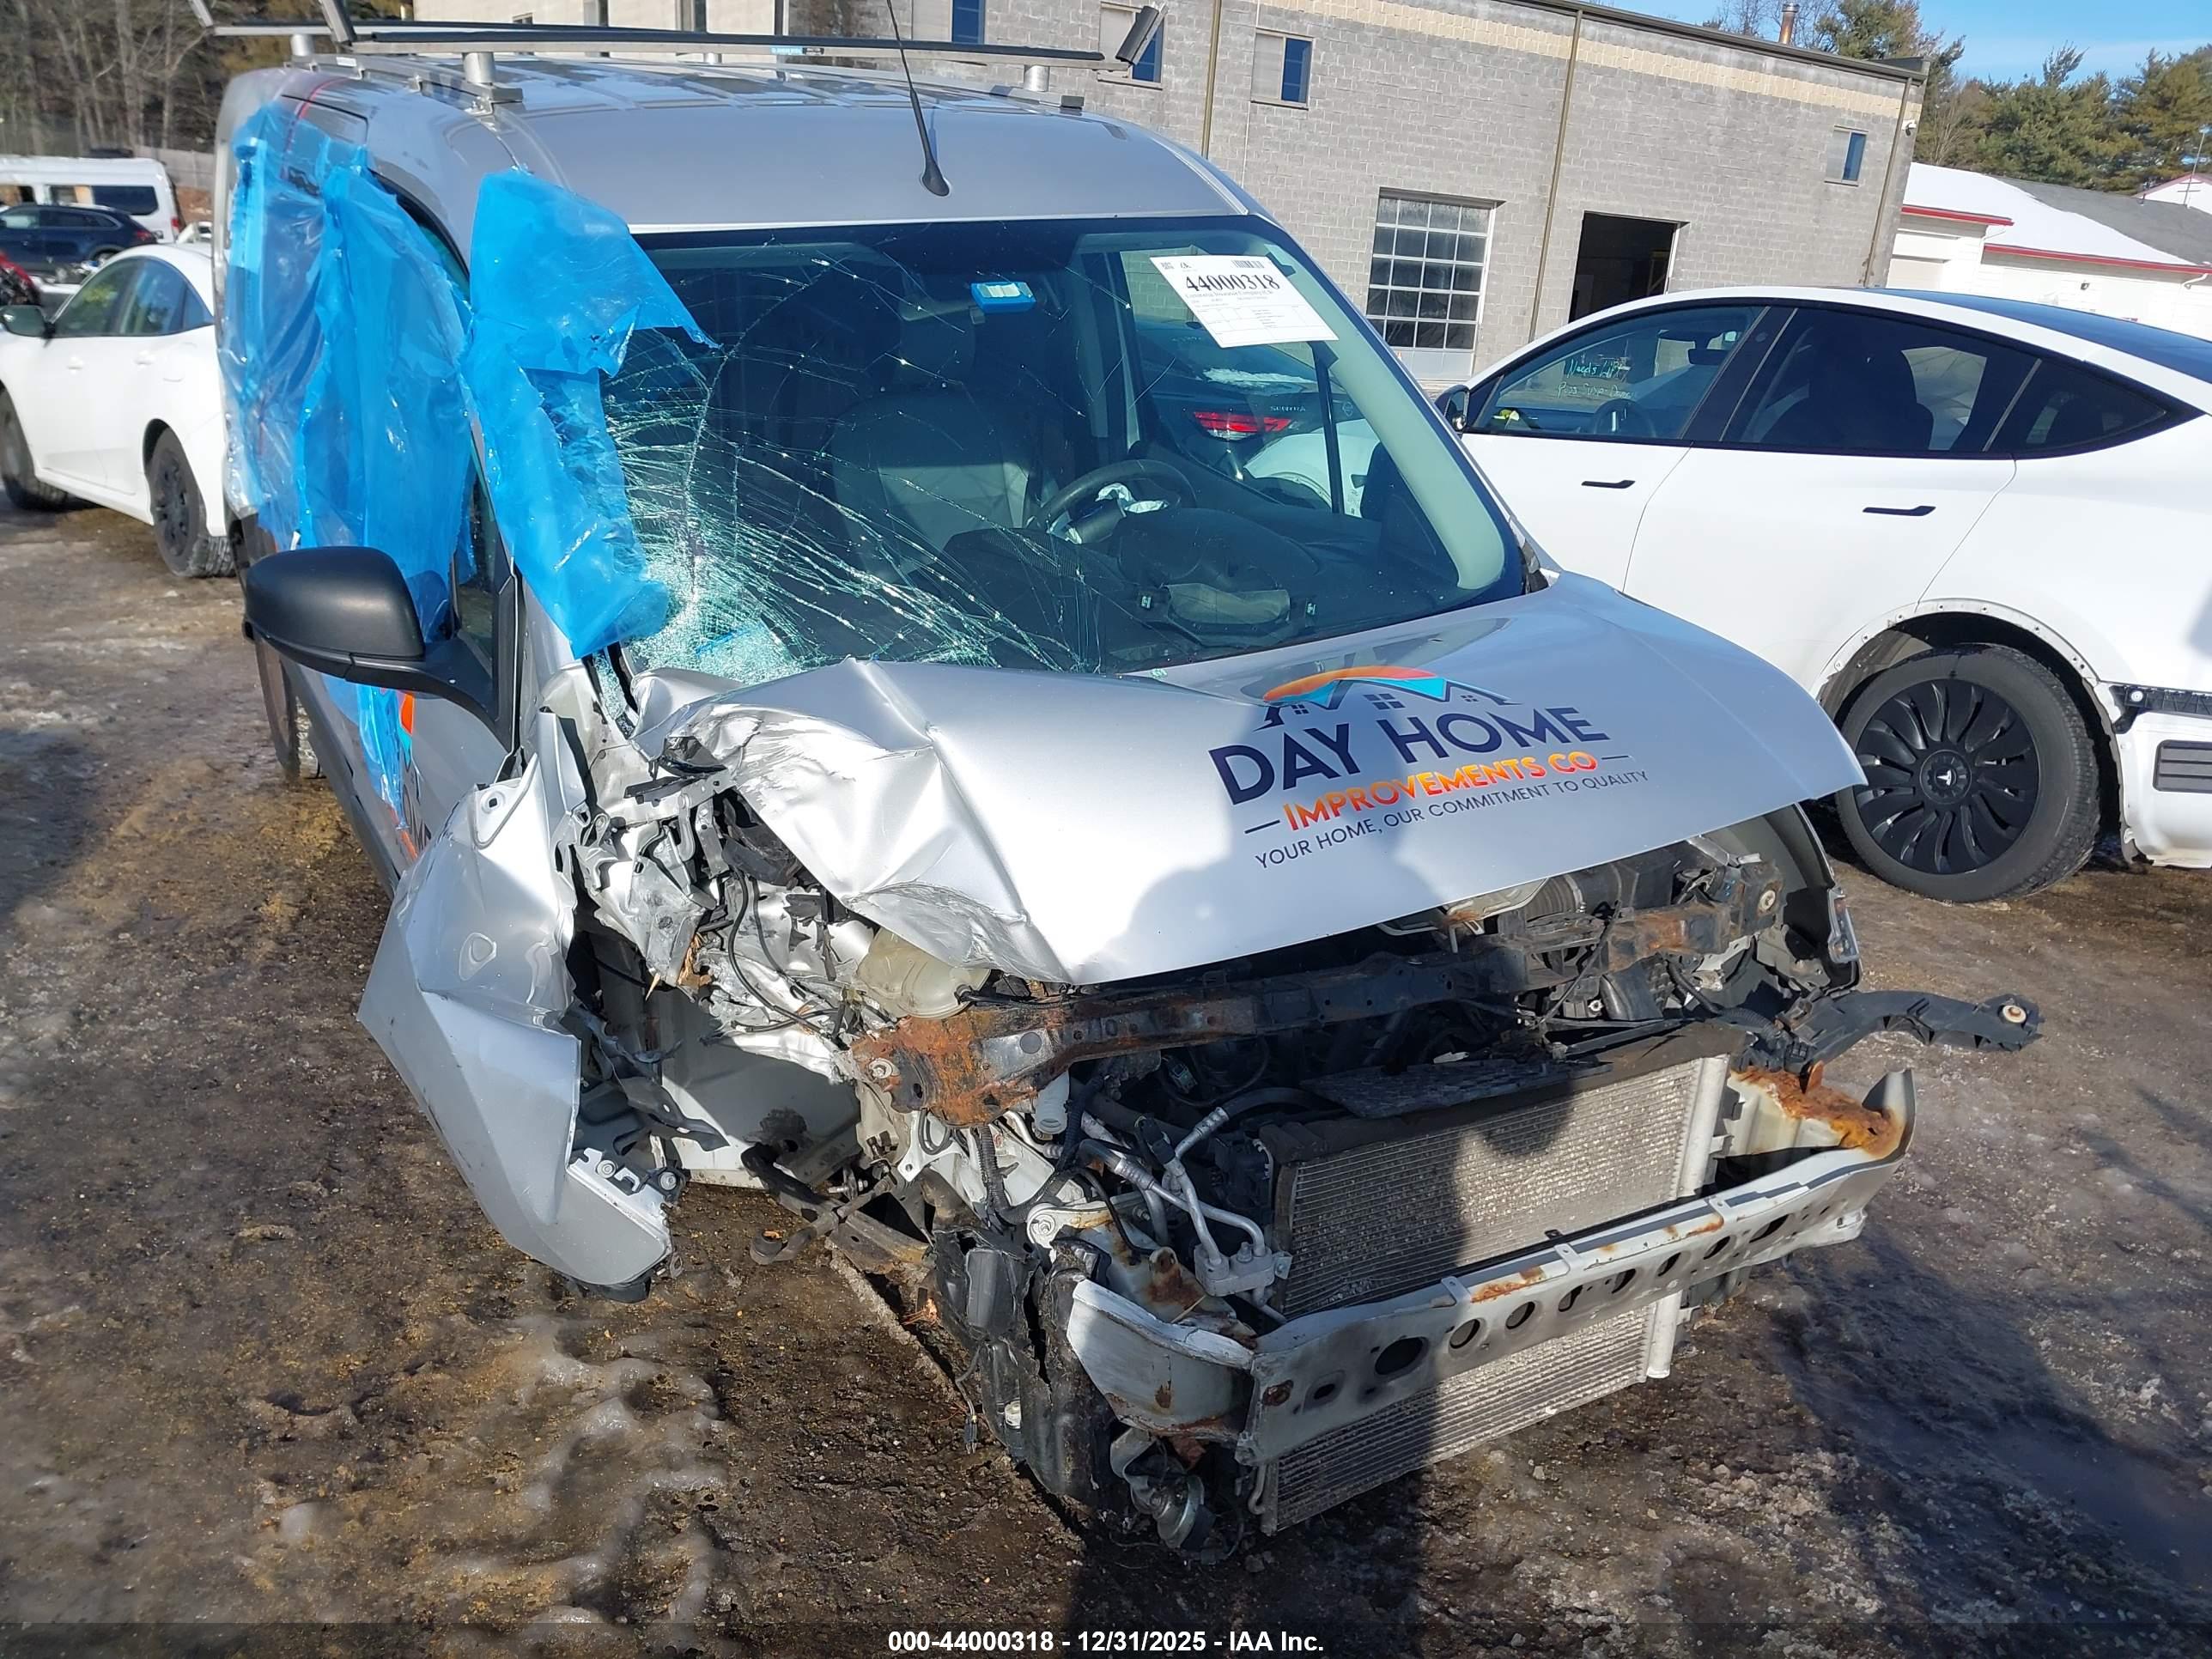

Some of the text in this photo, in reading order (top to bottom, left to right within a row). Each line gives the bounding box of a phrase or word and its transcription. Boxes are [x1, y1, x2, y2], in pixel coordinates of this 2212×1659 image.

[1186, 274, 1280, 291] 44000318
[1208, 707, 1611, 805] DAY HOME
[1283, 750, 1598, 830] IMPROVEMENTS CO
[1255, 770, 1649, 869] YOUR HOME, OUR COMMITMENT TO QUALITY
